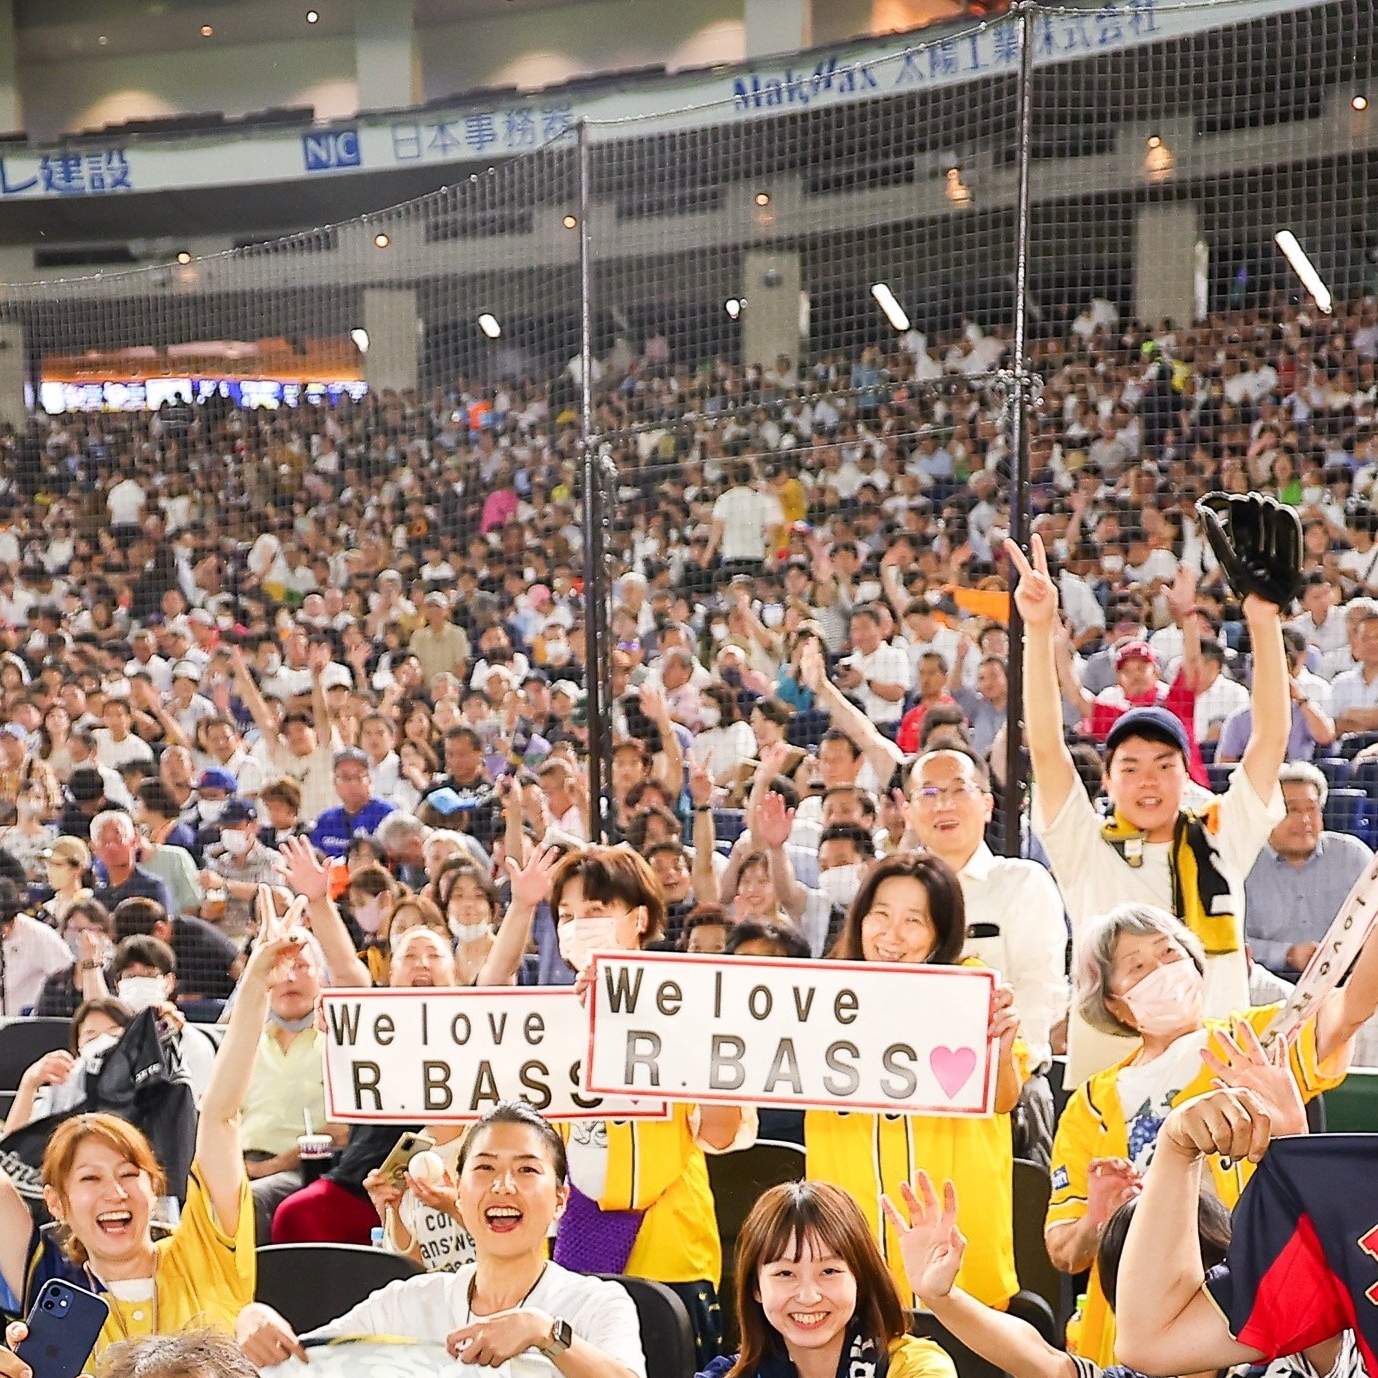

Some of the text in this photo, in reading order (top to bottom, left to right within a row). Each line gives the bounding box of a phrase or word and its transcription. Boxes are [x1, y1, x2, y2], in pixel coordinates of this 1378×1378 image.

[328, 1002, 546, 1047] We love
[604, 964, 860, 1025] We love
[624, 1028, 919, 1101] R.BASS
